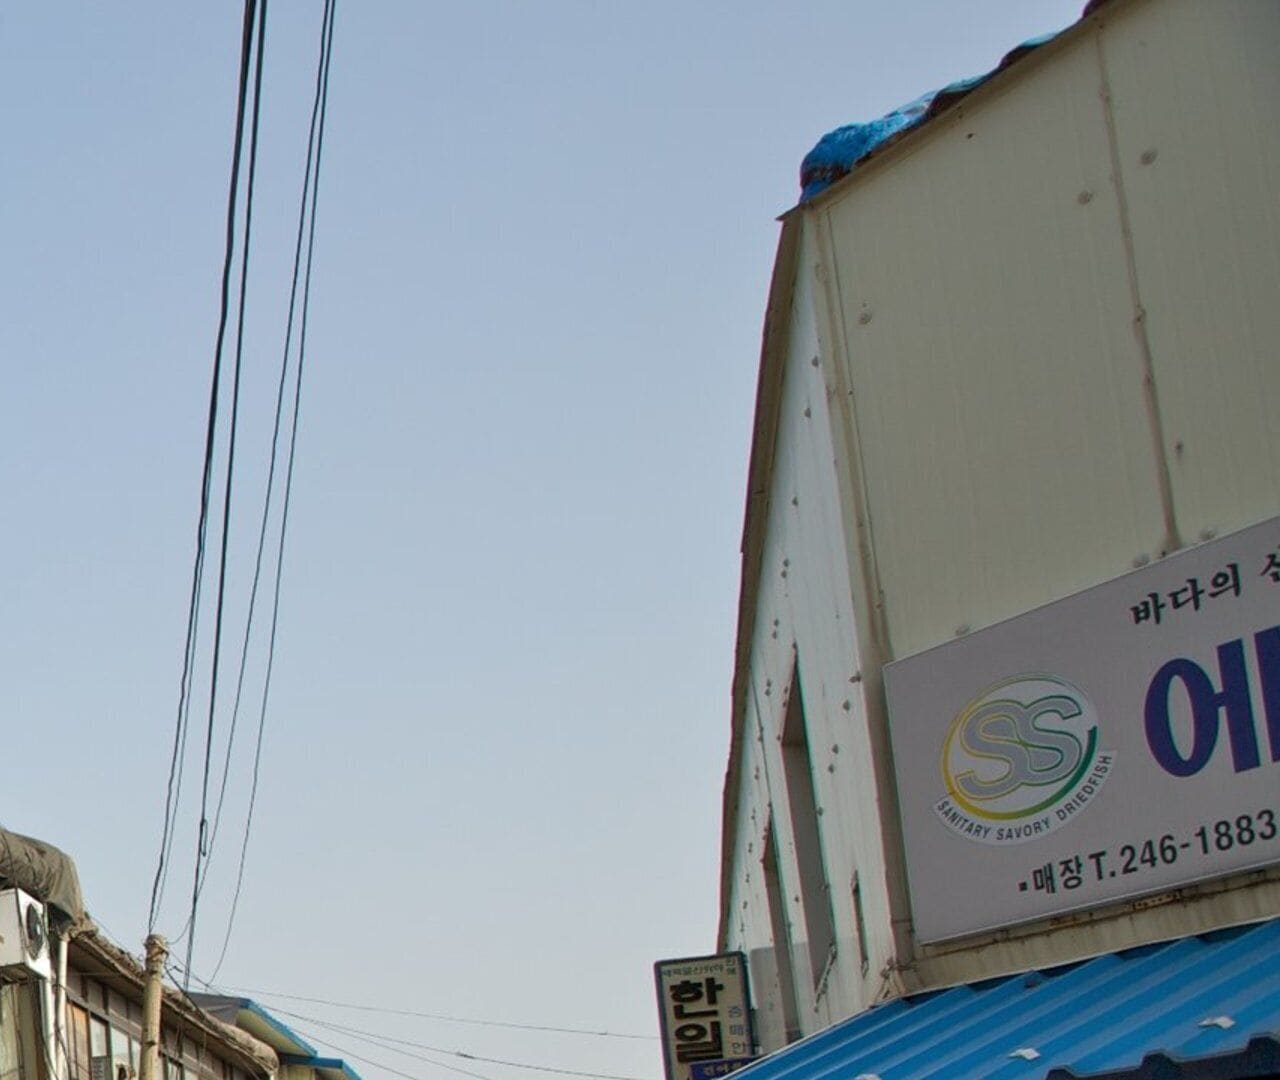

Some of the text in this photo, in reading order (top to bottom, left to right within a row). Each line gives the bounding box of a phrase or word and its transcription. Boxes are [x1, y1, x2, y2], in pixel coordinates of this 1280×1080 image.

[1130, 563, 1241, 626] 바다의
[954, 694, 1082, 802] SS
[937, 755, 1113, 841] SANITARY SAVORY DRIEDFISH
[1032, 808, 1278, 895] 매장 T.246-1883
